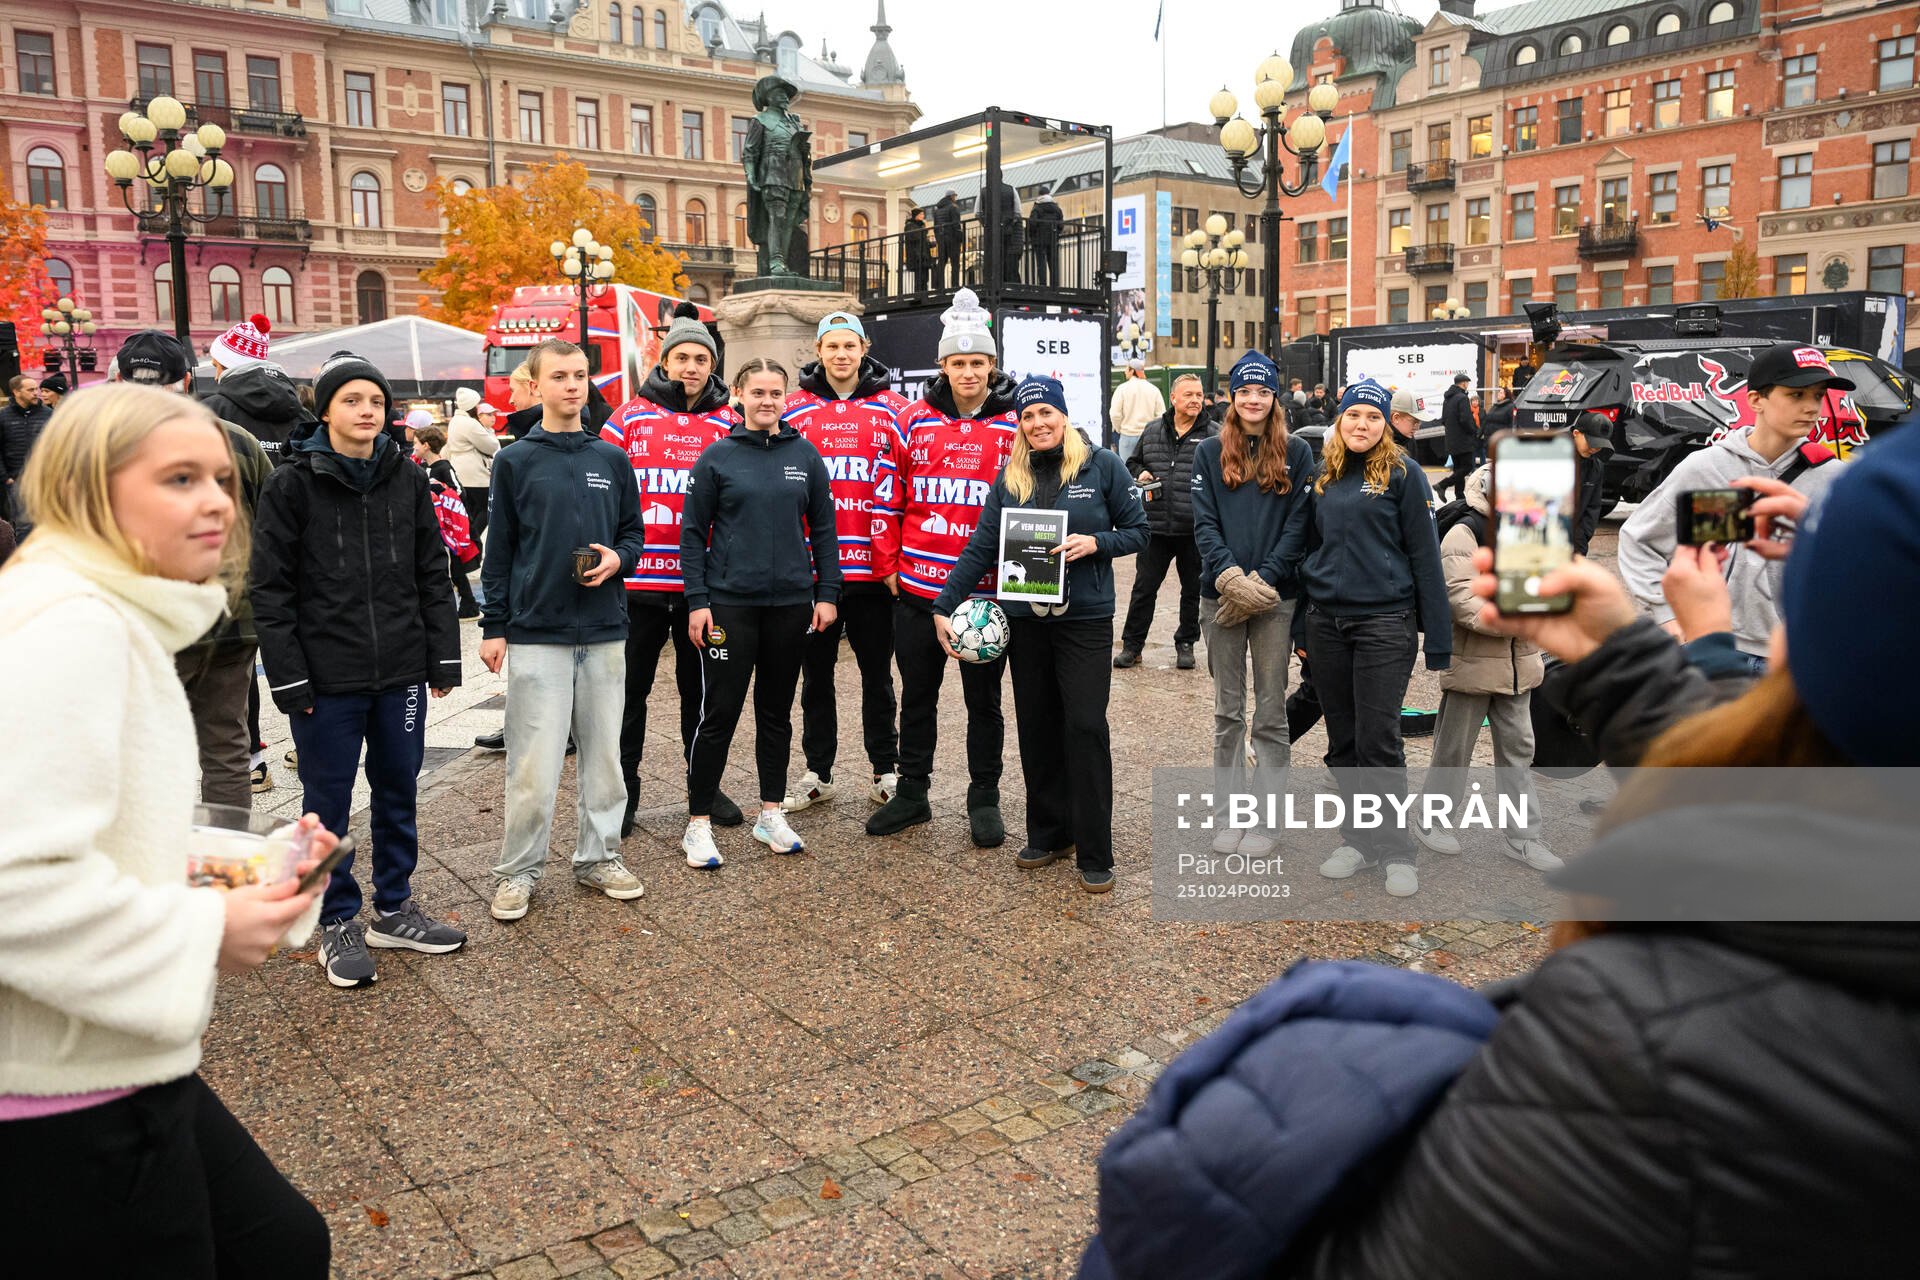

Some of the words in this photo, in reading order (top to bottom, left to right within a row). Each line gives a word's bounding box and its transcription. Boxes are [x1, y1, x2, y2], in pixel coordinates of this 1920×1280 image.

[1037, 340, 1070, 354] SEB
[1398, 354, 1425, 364] SEB
[890, 367, 903, 381] HL
[1551, 384, 1572, 395] Bull
[1631, 382, 1668, 402] Red
[1667, 382, 1705, 402] Bull
[1534, 412, 1567, 423] REDBULLTEN
[821, 422, 858, 431] HIGHCON
[663, 434, 702, 444] HIGHCON
[944, 442, 983, 452] HIGHCON
[874, 473, 895, 502] 4
[912, 476, 991, 507] TIMR
[708, 647, 729, 660] OE
